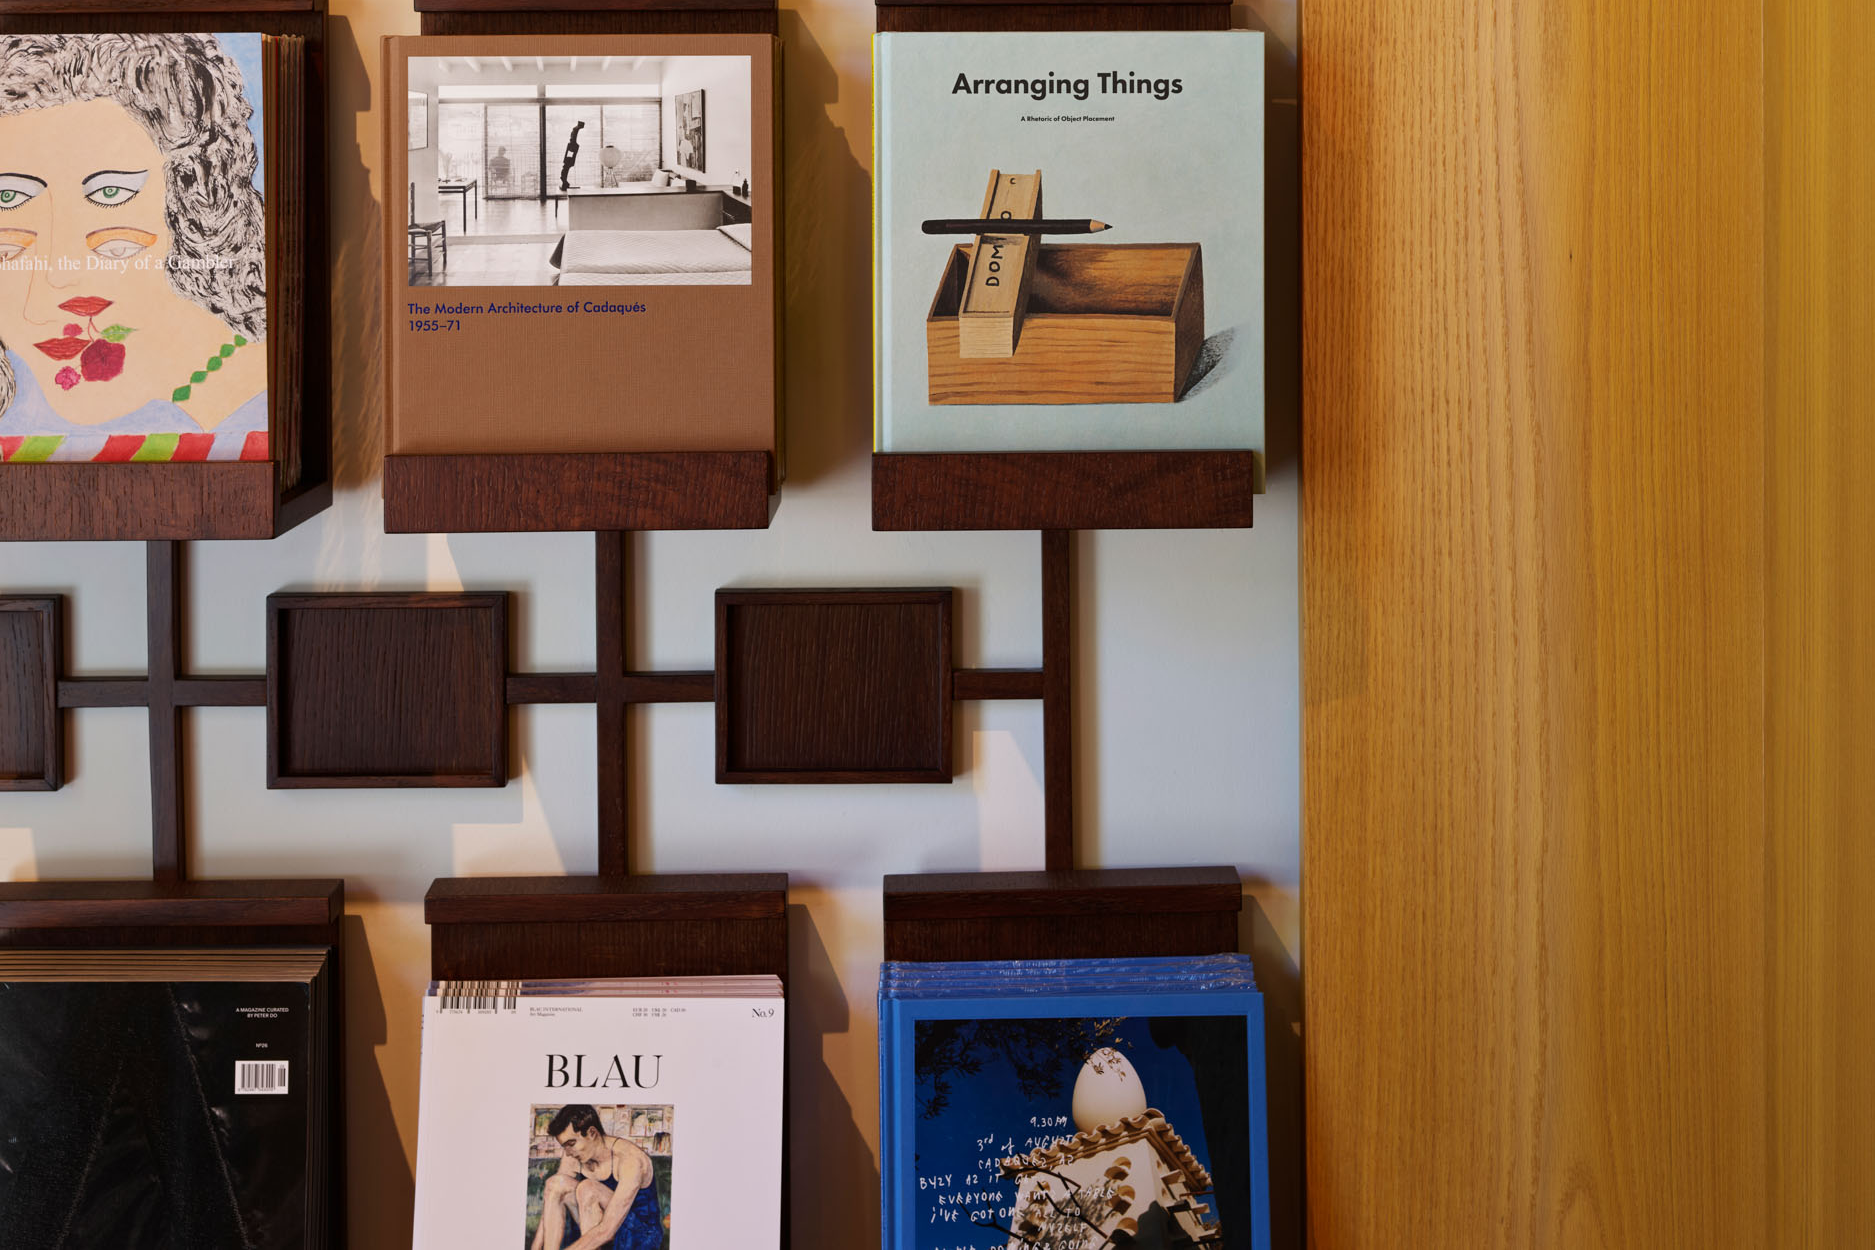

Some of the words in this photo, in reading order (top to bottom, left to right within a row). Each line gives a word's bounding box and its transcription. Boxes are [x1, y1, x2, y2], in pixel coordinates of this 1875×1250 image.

[952, 71, 1089, 100] Arranging
[1097, 71, 1183, 100] Things
[58, 256, 81, 270] the
[87, 256, 132, 274] Diary
[135, 255, 150, 270] of
[155, 258, 164, 270] a
[168, 255, 235, 269] Gambler
[408, 303, 430, 314] The
[435, 302, 484, 314] Modern
[488, 302, 562, 314] Architecture
[567, 301, 580, 313] of
[583, 301, 646, 315] Cadaqués
[544, 1054, 663, 1088] BLAU
